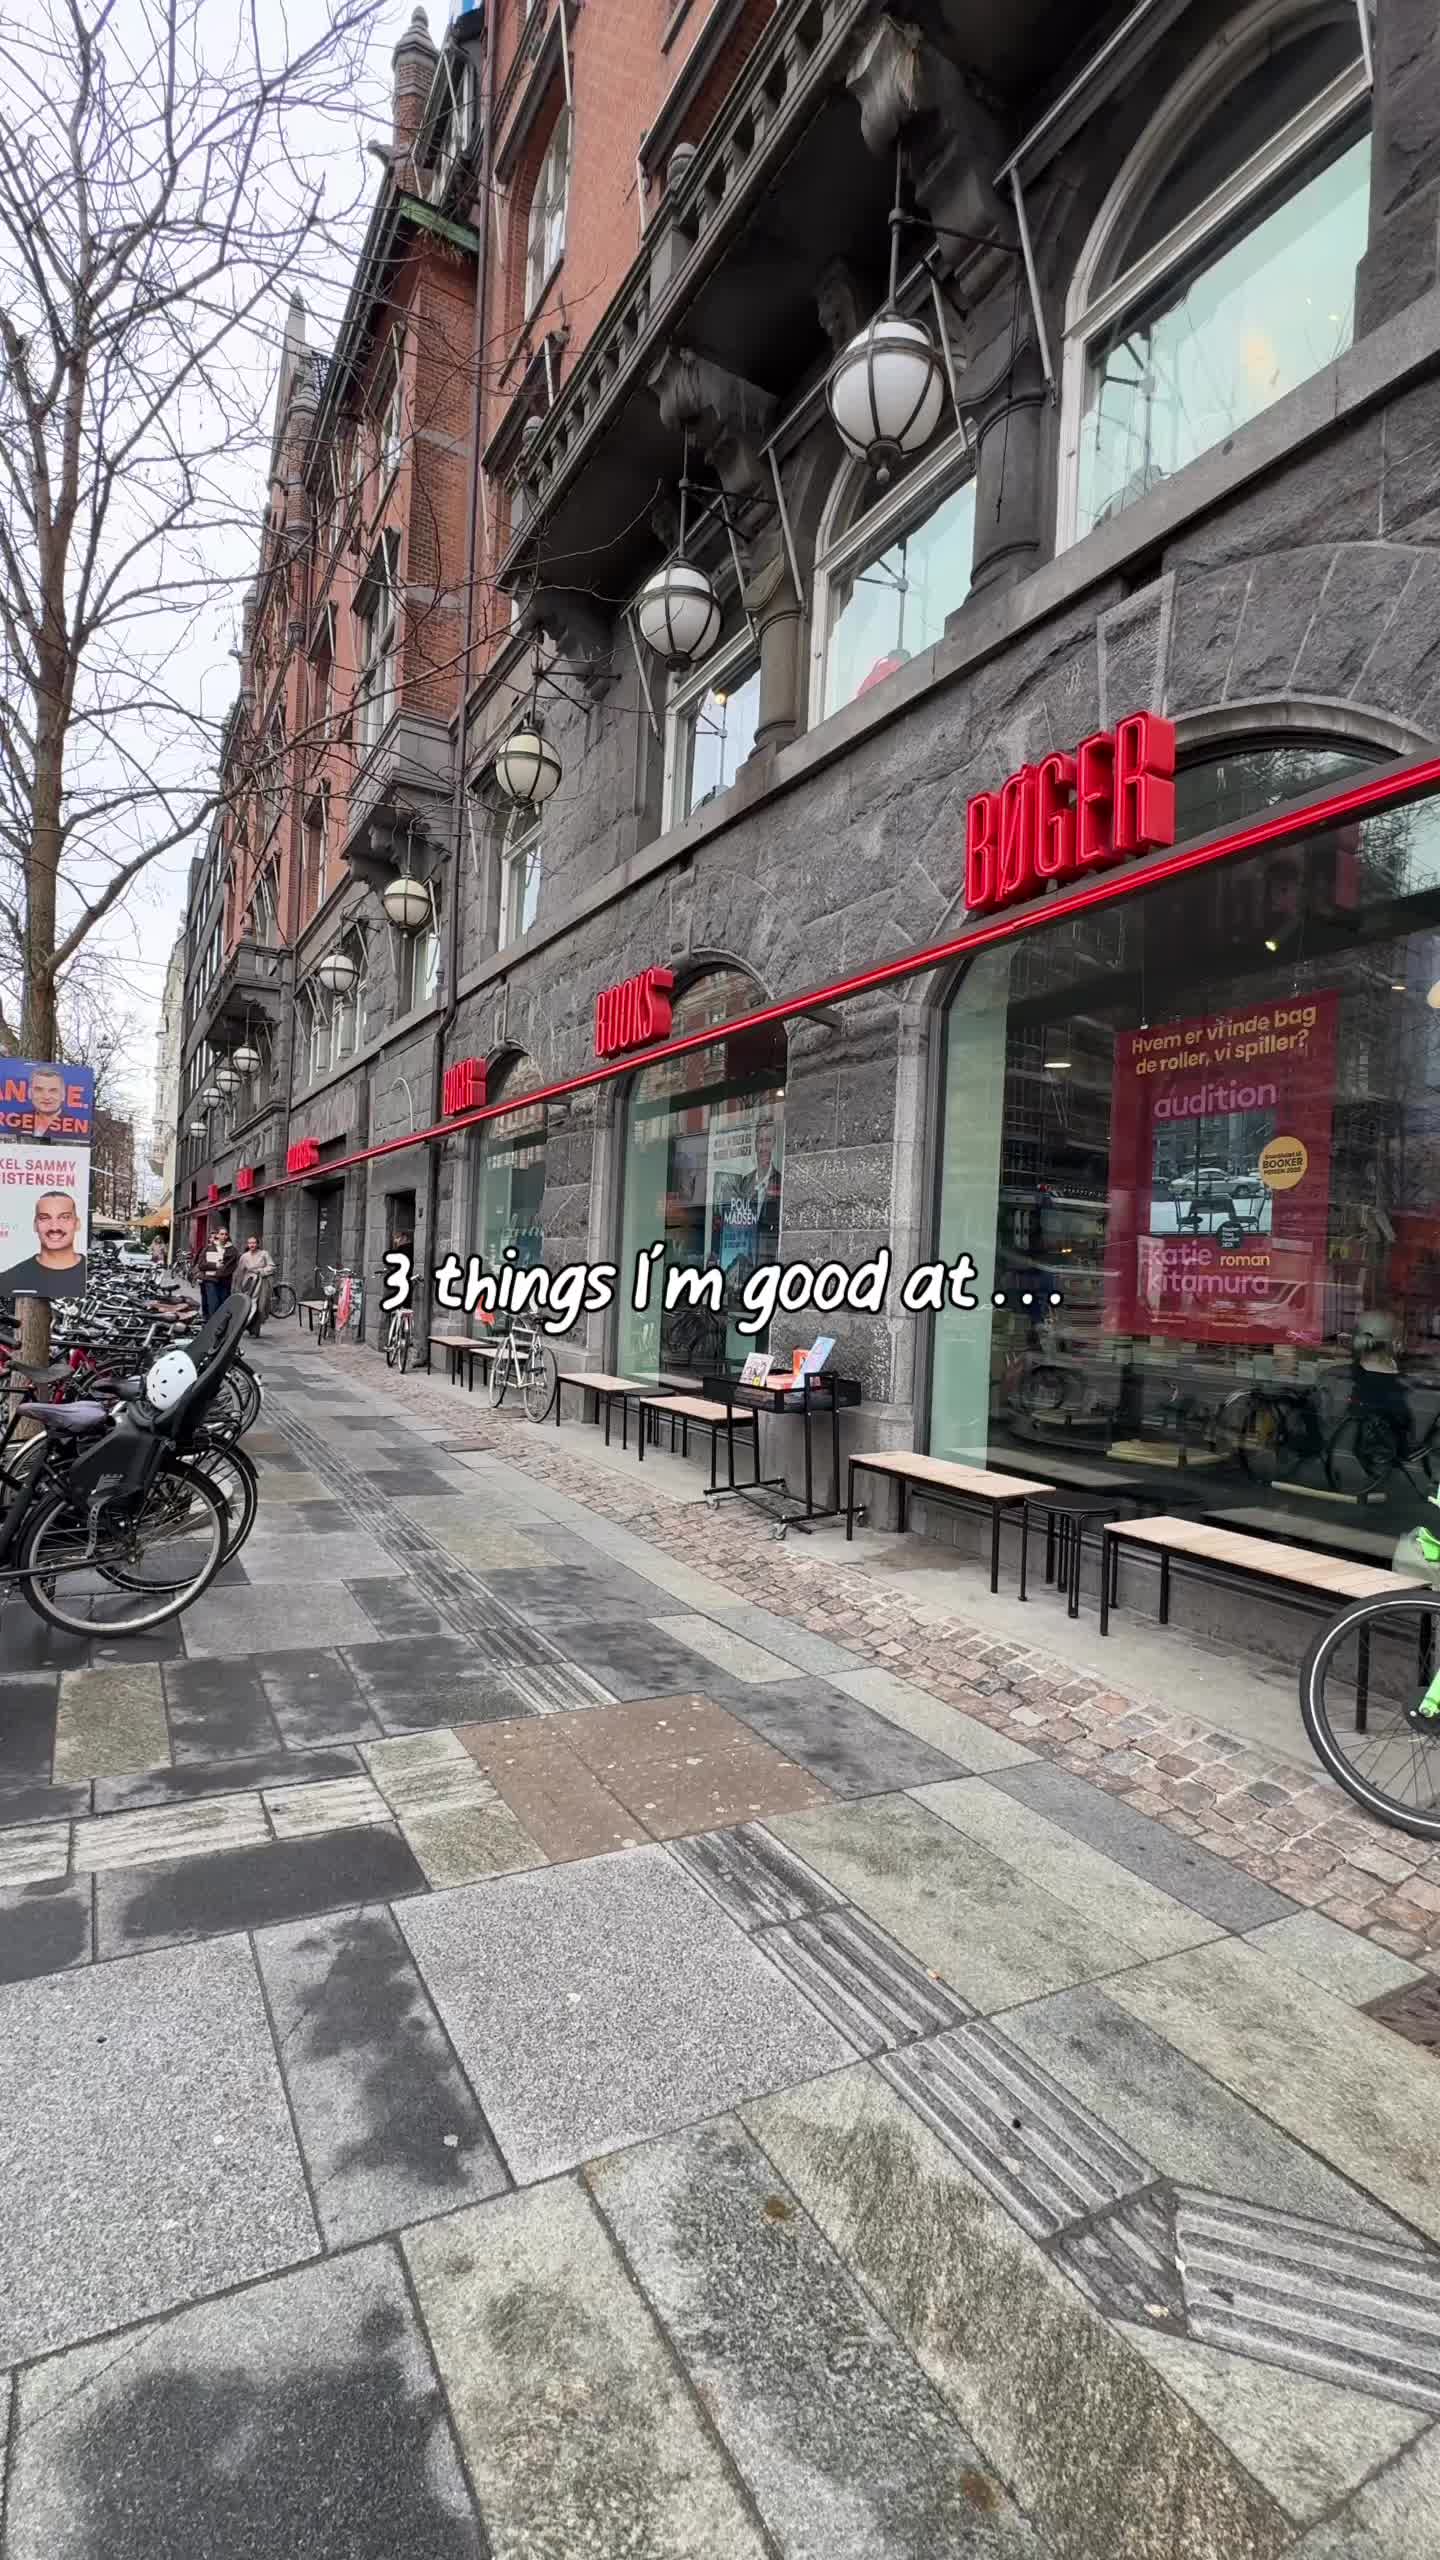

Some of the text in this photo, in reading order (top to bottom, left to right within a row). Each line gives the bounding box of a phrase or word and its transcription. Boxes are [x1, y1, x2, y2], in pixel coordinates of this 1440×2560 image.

[965, 710, 1176, 911] BØGER
[595, 966, 673, 1059] BOOKS
[1131, 1034, 1182, 1055] Hvem
[1184, 1030, 1203, 1046] er
[1274, 1006, 1317, 1028] bag
[1135, 1057, 1157, 1075] de
[1214, 1042, 1231, 1063] vi
[1234, 1029, 1310, 1064] spiller?
[1153, 1080, 1277, 1119] audition
[24, 1160, 77, 1172] SAMMY
[1262, 1157, 1304, 1169] BOOKER
[1219, 1254, 1271, 1267] roman
